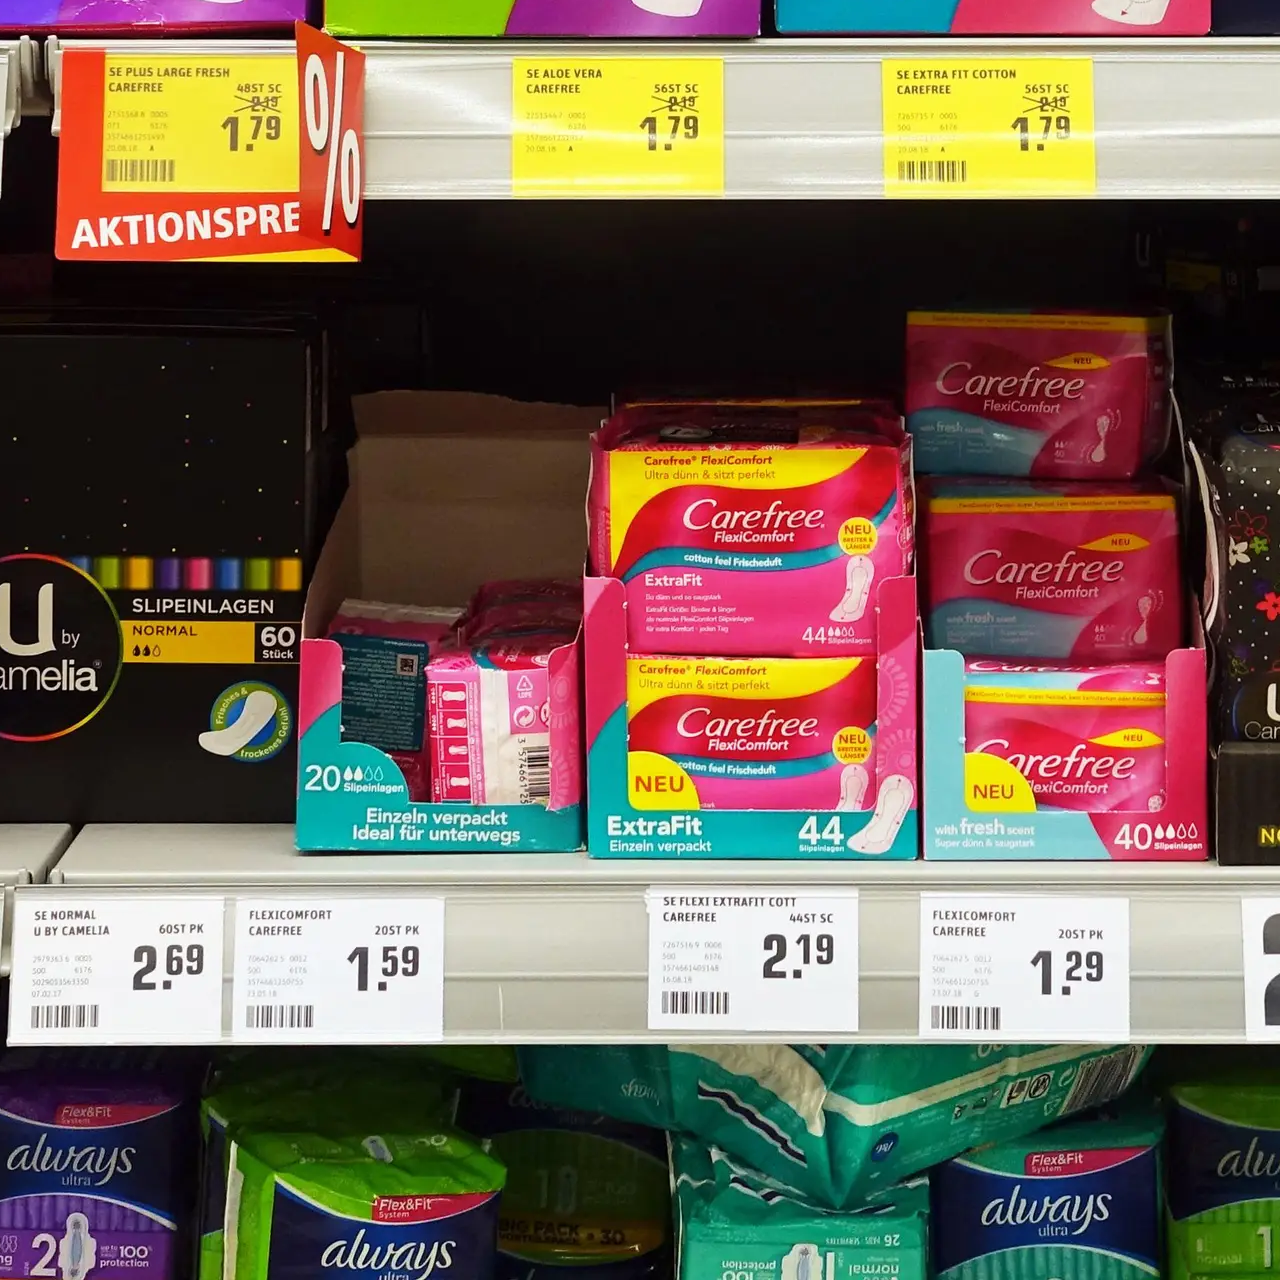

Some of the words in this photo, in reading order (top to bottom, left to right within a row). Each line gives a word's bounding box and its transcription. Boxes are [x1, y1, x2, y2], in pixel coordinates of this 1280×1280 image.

[639, 116, 699, 152] 1.79
[132, 596, 274, 614] SLIPEINLAGEN
[305, 765, 339, 791] 20
[634, 773, 684, 793] NEU
[367, 808, 430, 828] Einzeln
[436, 808, 508, 828] verpackt
[608, 816, 703, 837] ExtraFit
[352, 824, 401, 842] Ideal
[406, 824, 433, 841] für
[439, 825, 521, 844] unterwegs
[982, 1182, 1112, 1233] always
